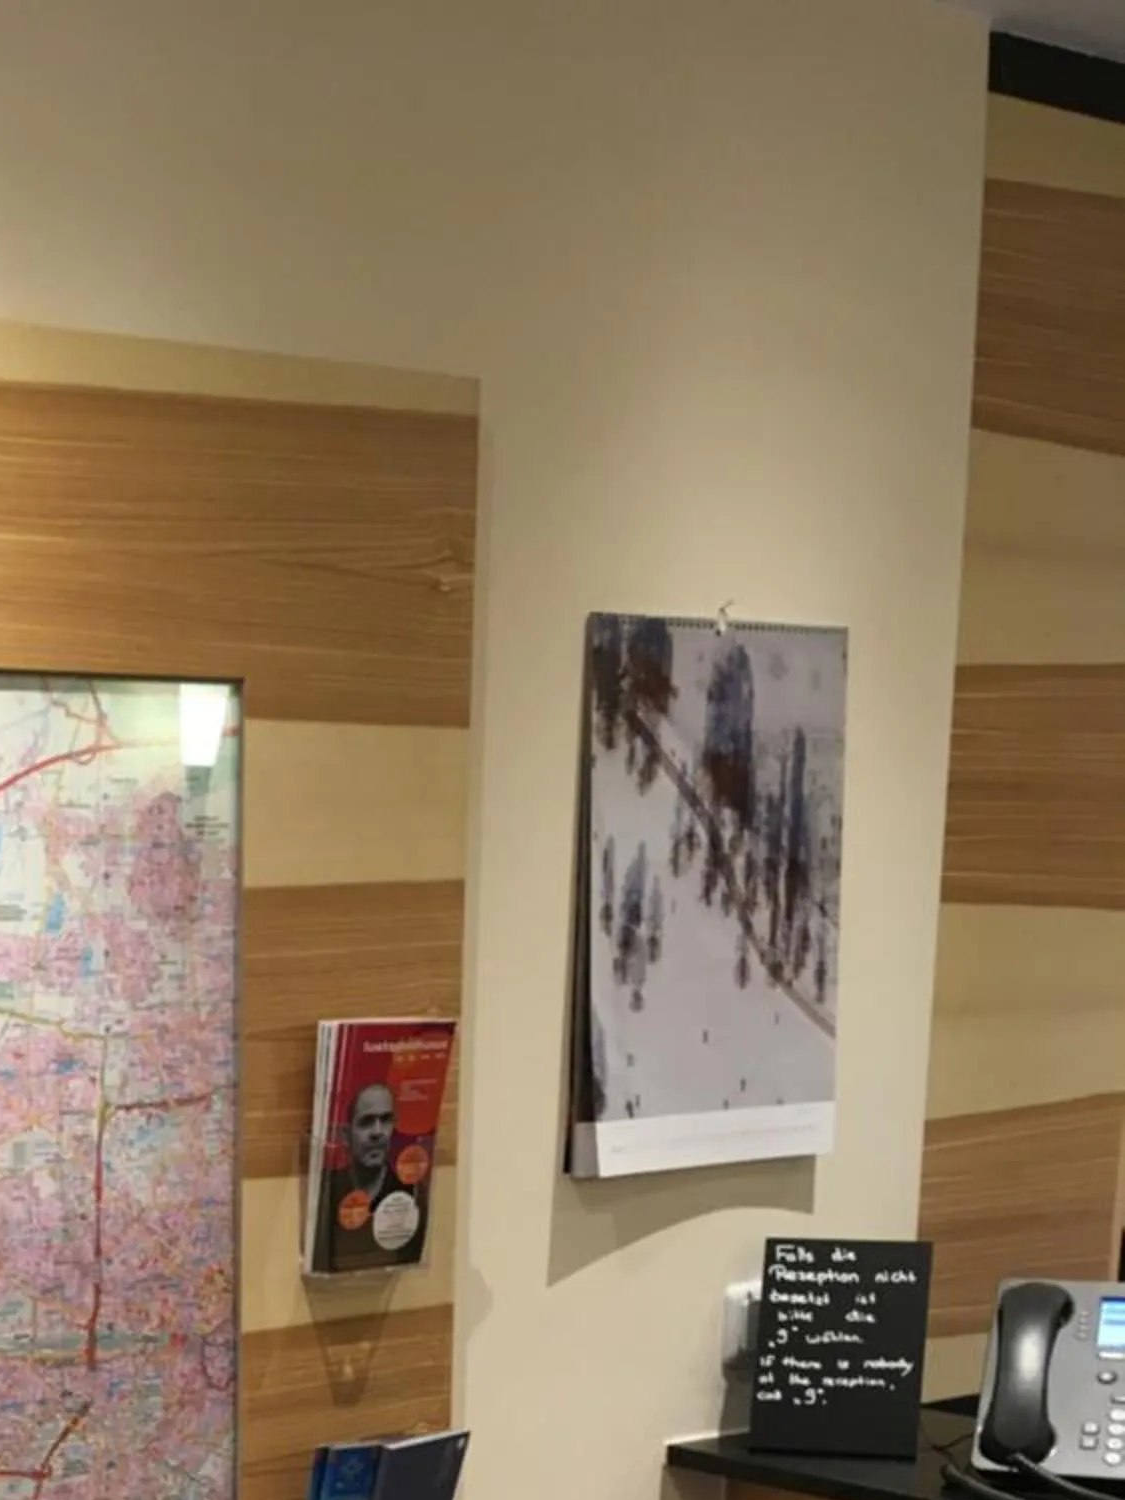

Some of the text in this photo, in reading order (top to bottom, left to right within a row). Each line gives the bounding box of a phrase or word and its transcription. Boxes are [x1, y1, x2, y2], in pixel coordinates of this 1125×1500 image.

[776, 1245, 857, 1263] Falls die
[768, 1263, 917, 1286] Rezeption nicht
[855, 1292, 876, 1304] ist
[778, 1309, 876, 1323] bitte die
[782, 1356, 822, 1370] there
[837, 1359, 850, 1370] is
[863, 1357, 914, 1376] nobody
[758, 1372, 774, 1384] at
[788, 1373, 811, 1386] the
